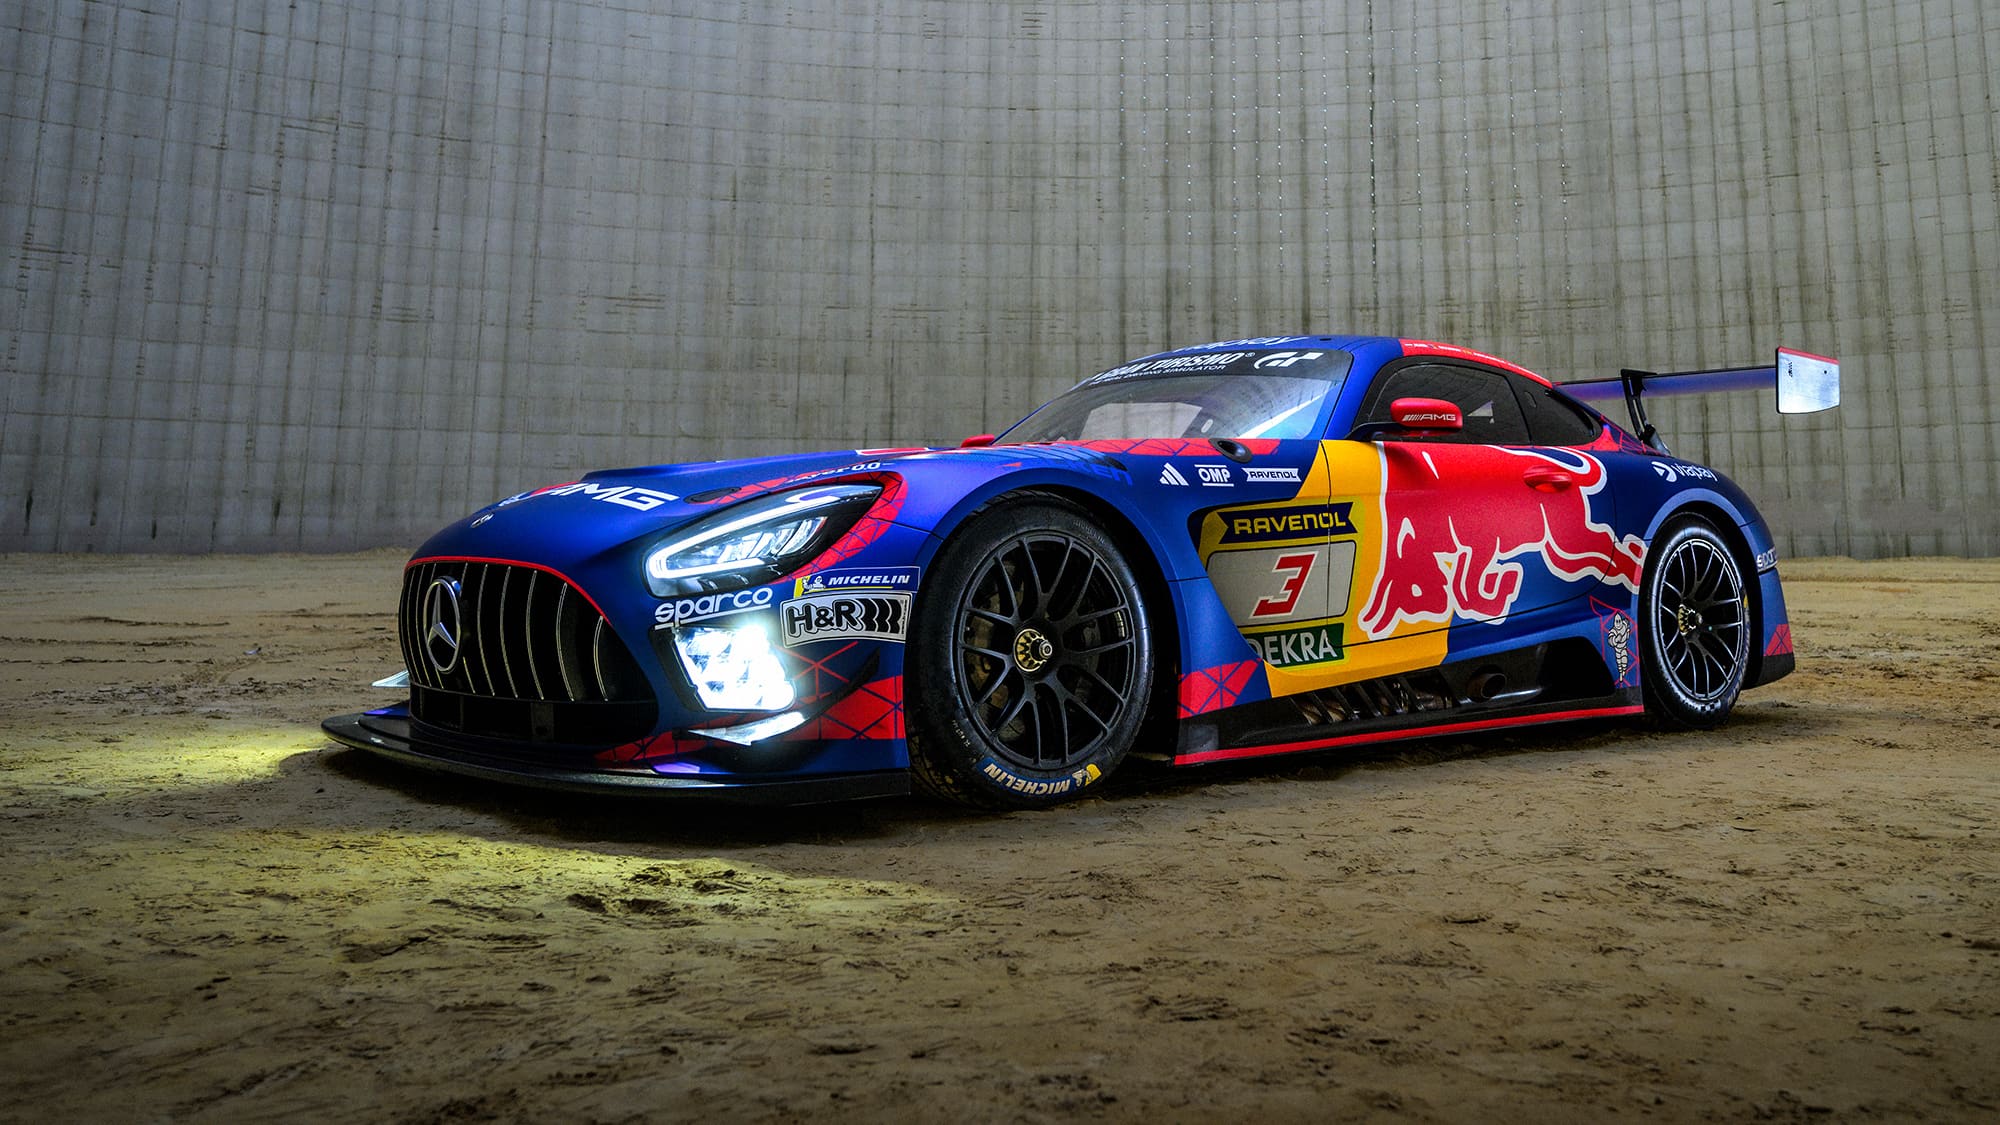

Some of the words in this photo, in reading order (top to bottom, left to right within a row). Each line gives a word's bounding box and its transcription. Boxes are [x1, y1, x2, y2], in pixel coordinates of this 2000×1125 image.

[1198, 468, 1231, 483] OMP
[1249, 471, 1297, 479] RAVENOL
[1233, 511, 1347, 535] RAVENOL
[828, 575, 910, 586] MICHELIN
[1250, 551, 1319, 619] 3
[655, 588, 773, 628] sparco
[786, 599, 862, 637] H&R
[984, 763, 1071, 794] MICHELIN
